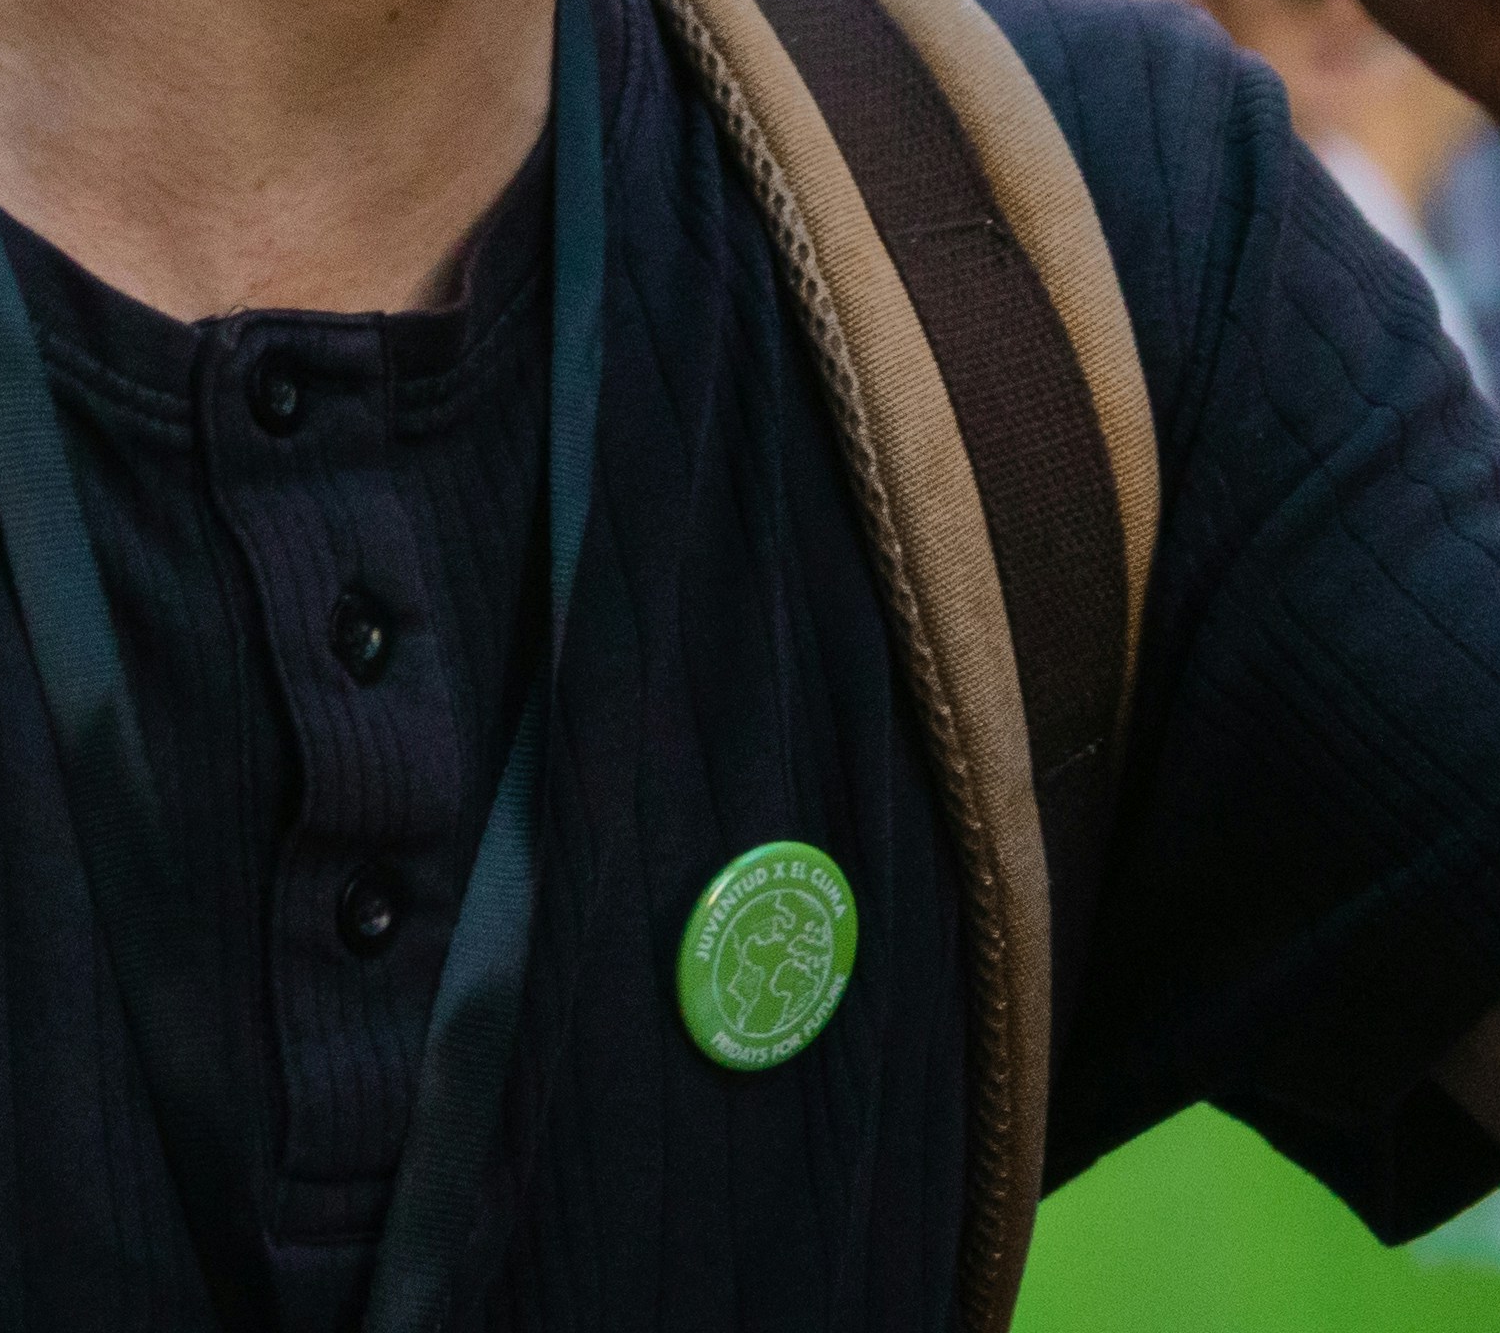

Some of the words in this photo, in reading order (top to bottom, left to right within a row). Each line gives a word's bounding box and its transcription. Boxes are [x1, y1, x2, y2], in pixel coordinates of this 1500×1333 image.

[695, 867, 769, 962] JUVENTUD
[773, 861, 785, 879] X
[790, 861, 808, 880] EL
[810, 867, 847, 919] CLIMA
[711, 1030, 769, 1064] FRIDAYS
[772, 1033, 802, 1060] FOR
[803, 973, 847, 1036] FUTURE
